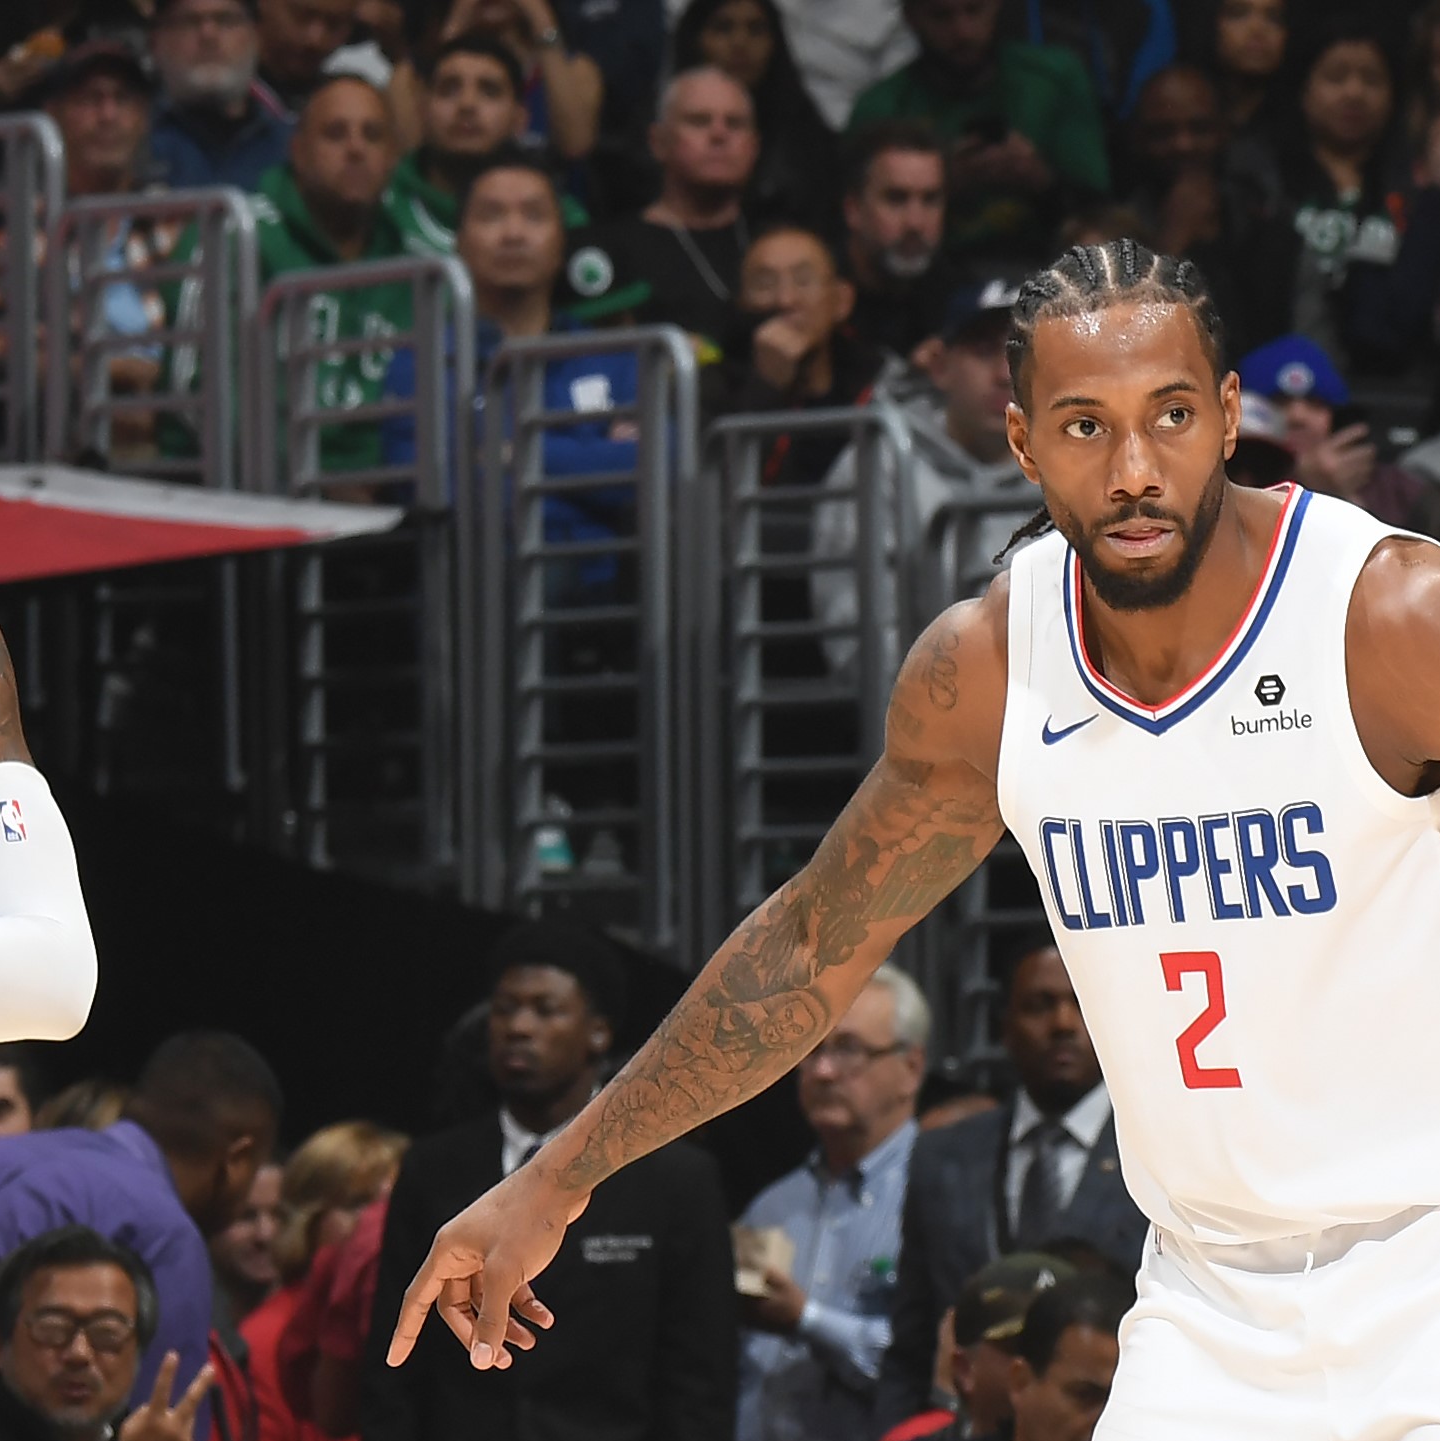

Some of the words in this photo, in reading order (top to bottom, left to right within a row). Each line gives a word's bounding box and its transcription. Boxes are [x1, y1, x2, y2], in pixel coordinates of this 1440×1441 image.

[1230, 708, 1313, 736] bumble
[1038, 800, 1338, 931] CLIPPERS
[1158, 950, 1244, 1090] 2
